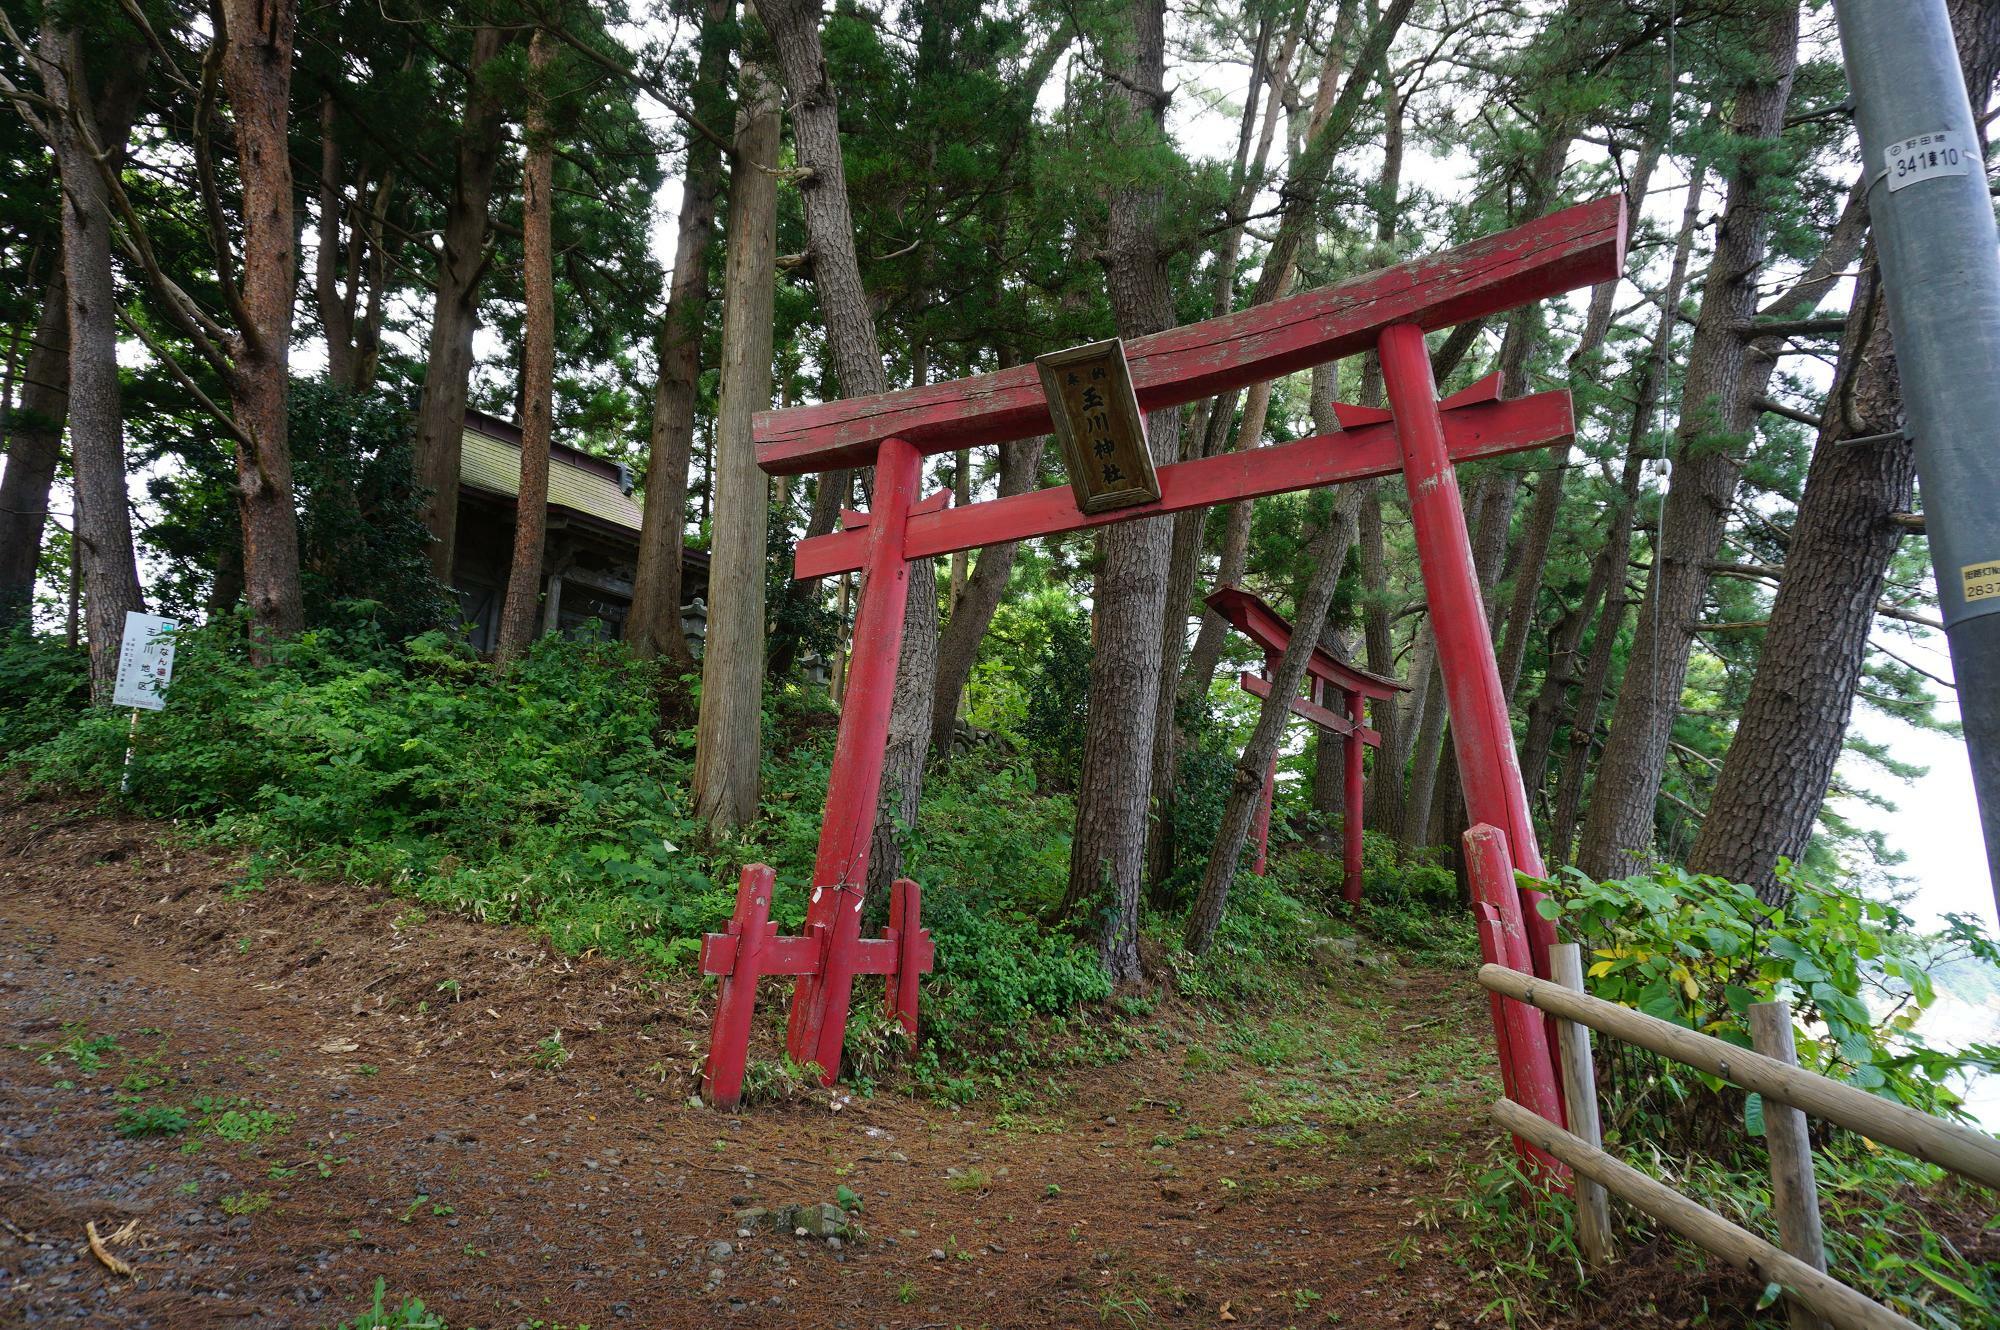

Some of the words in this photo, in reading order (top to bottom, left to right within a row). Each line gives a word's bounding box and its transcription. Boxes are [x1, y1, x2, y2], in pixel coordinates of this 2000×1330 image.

[1897, 148, 1958, 177] 341東10
[1082, 386, 1127, 485] 玉川神社
